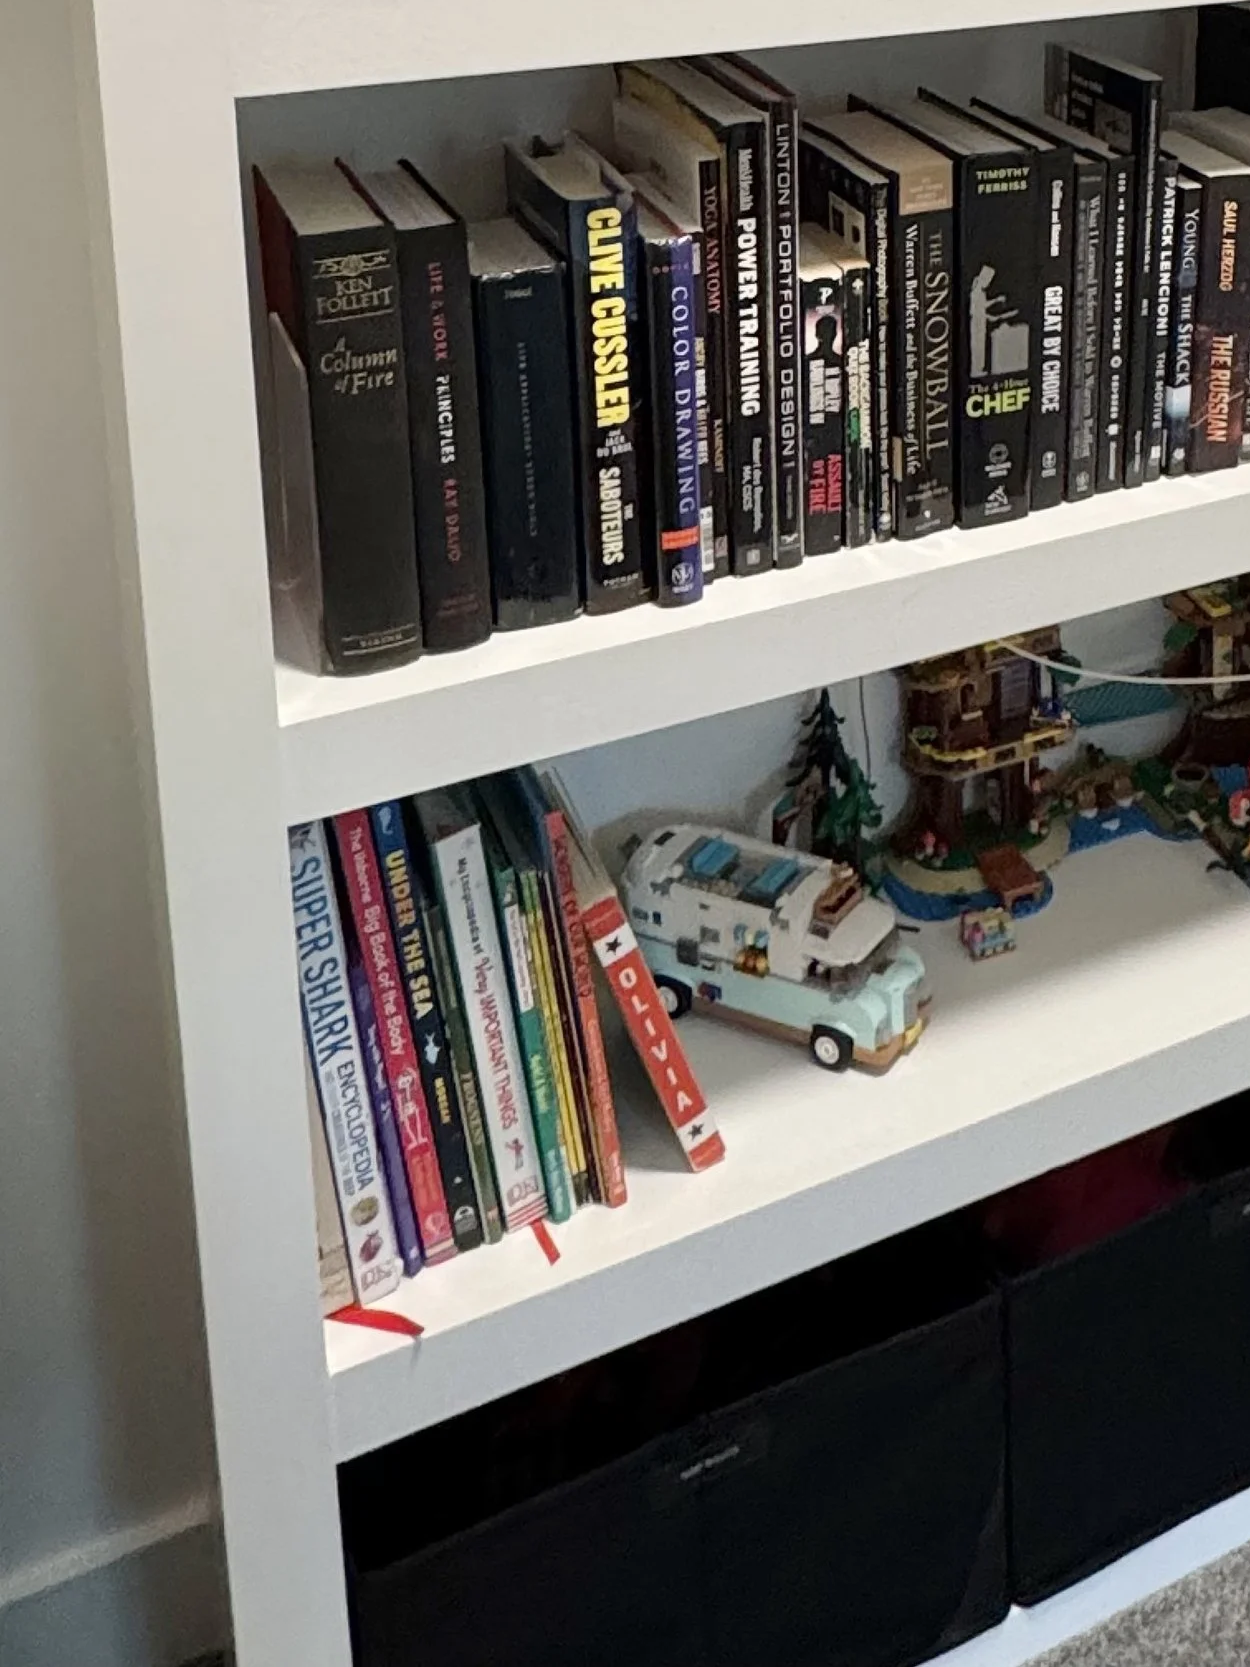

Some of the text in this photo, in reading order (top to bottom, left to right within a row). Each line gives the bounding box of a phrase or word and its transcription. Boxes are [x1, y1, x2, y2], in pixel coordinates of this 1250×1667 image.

[975, 167, 1030, 181] TIMOTHY
[334, 276, 372, 296] KEN
[703, 185, 722, 315] YOGA ANATOMY
[775, 122, 796, 455] LINTON PORTFOLIO DESIGN
[1155, 176, 1177, 337] PATRICK LENCIONI
[1218, 200, 1238, 292] SAUL HERZOG
[316, 286, 394, 316] FOLLETT
[335, 337, 346, 352] A
[586, 207, 630, 429] CLIVE CUSSLER
[737, 217, 761, 417] POWER TRAINING
[924, 230, 951, 460] THE SNOWBALL
[1041, 285, 1063, 415] GREAT BY CHOICE
[1175, 294, 1194, 386] THE SHACK
[320, 347, 398, 375] Column
[350, 371, 395, 395] Fire
[671, 286, 696, 516] COLOR DRAWING
[965, 386, 1031, 418] CHEF
[1153, 353, 1167, 430] THE MOTIVE
[1206, 335, 1234, 443] THE RUSSIAN
[599, 466, 625, 567] SABOTEURS
[291, 855, 334, 962] SUPER
[386, 849, 434, 1021] UNDER THE SEA
[303, 955, 356, 1068] SHARK
[618, 966, 693, 1113] OLIVIA
[337, 1059, 376, 1192] ENCYCLOPEDIA
